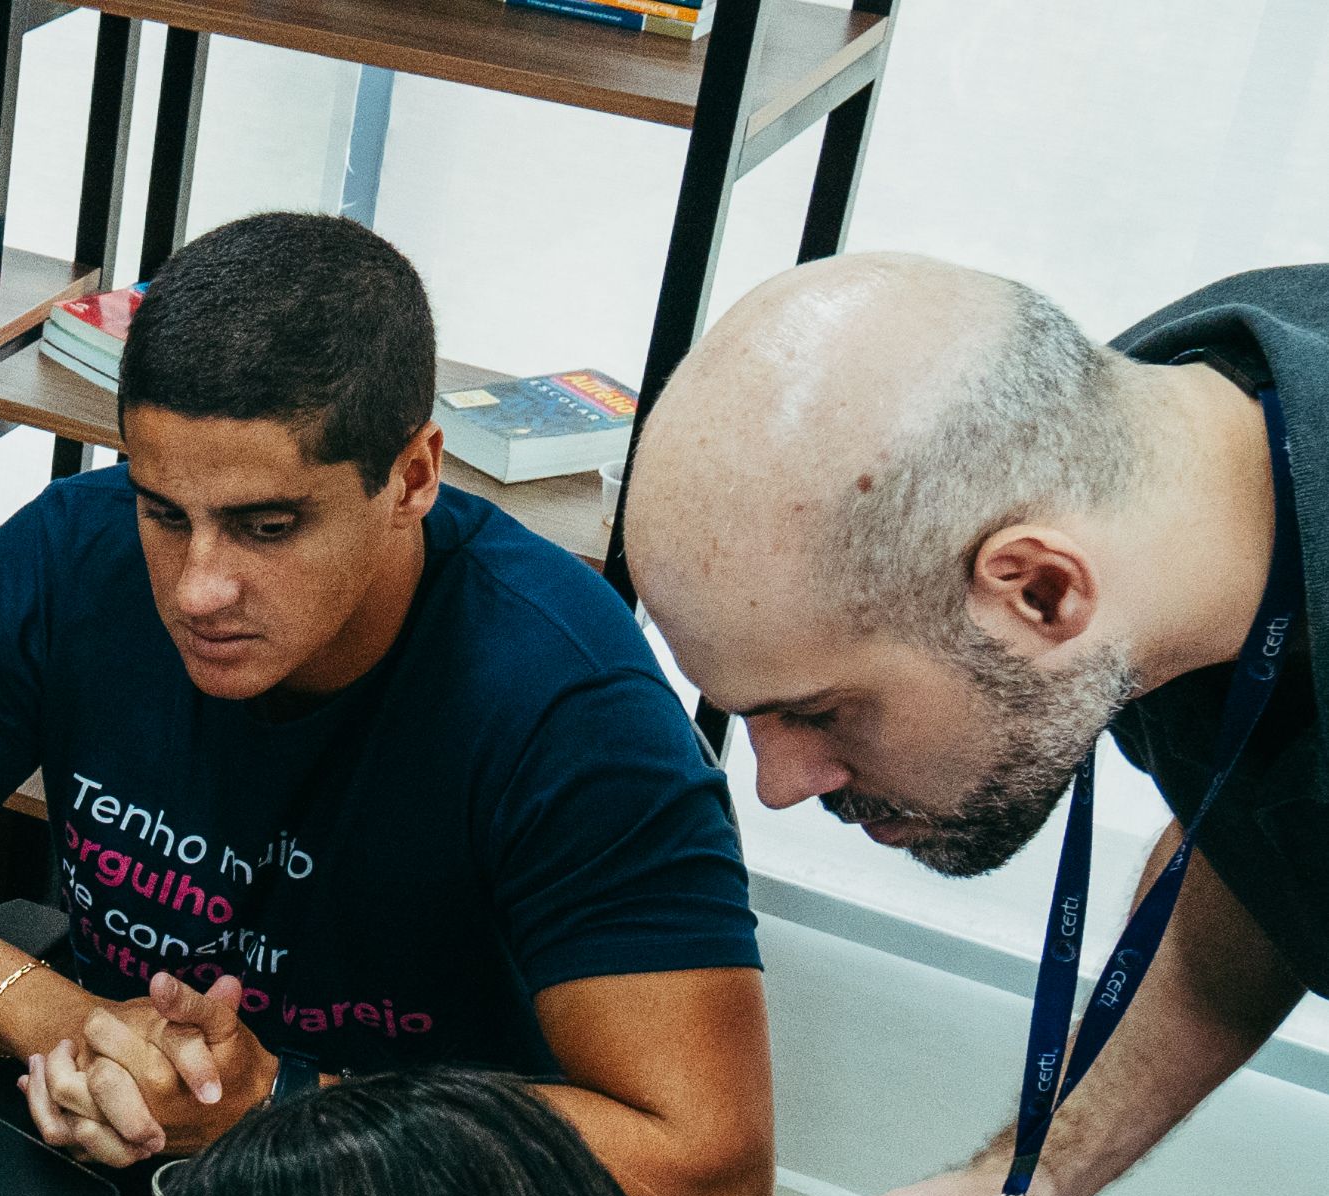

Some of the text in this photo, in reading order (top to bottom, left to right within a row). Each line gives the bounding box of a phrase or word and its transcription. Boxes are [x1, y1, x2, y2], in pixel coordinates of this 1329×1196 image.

[528, 379, 601, 423] ESCOLAR
[560, 371, 638, 417] Aurélio
[1262, 616, 1290, 657] certi
[73, 772, 207, 864] Tenho
[65, 820, 233, 924] orgulho
[1061, 896, 1078, 936] certi
[1097, 971, 1126, 1009] certi
[283, 994, 433, 1039] varejo
[1039, 1053, 1057, 1091] certi
